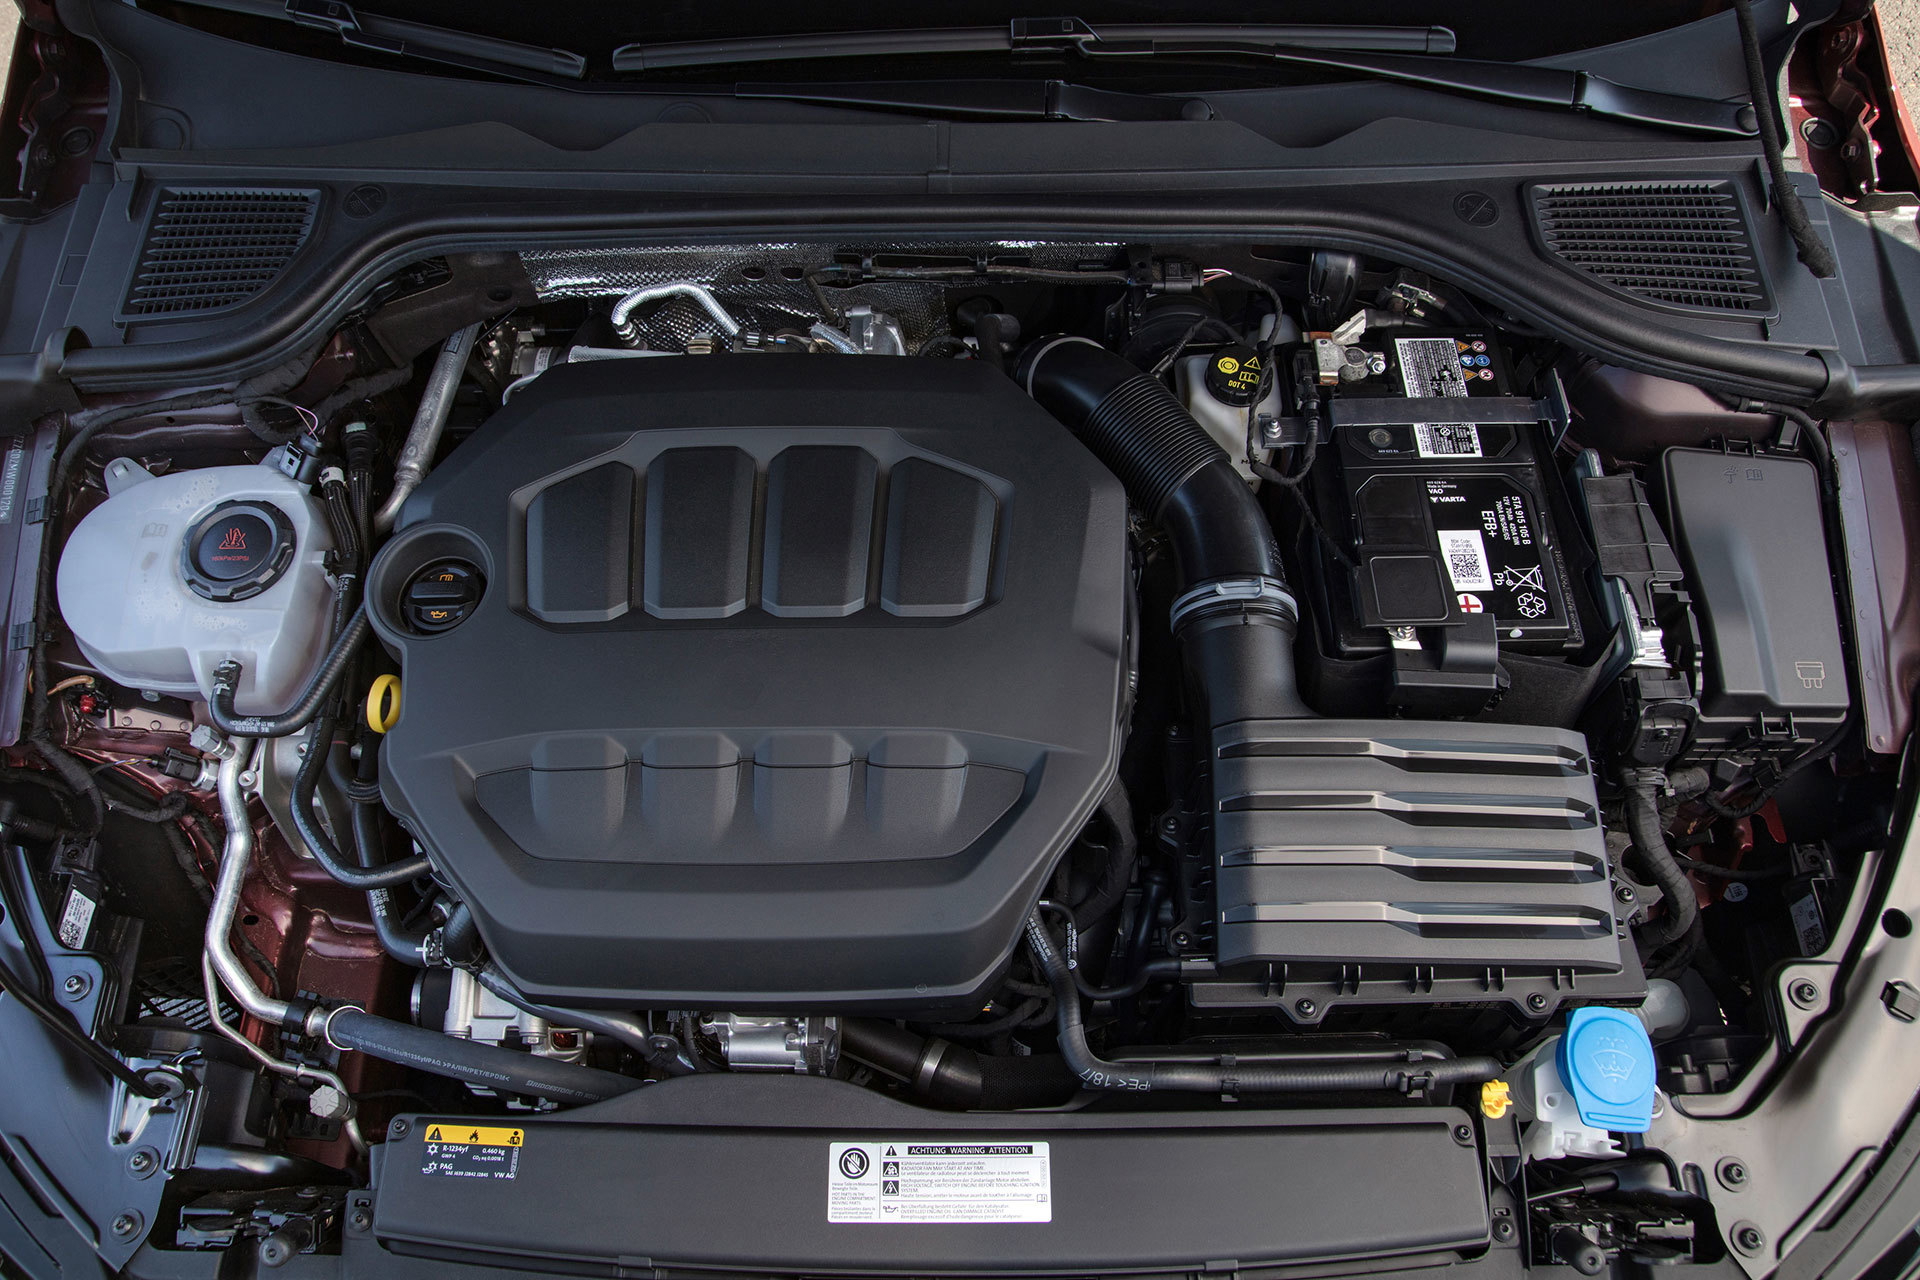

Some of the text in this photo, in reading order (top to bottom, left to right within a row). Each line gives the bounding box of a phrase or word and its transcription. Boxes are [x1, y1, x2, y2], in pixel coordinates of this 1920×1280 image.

[1228, 380, 1241, 388] DOT
[1512, 496, 1521, 509] 5TA
[1515, 510, 1526, 523] 915
[1481, 510, 1498, 537] EFB+
[1519, 526, 1530, 538] 105
[1493, 572, 1504, 586] Pb
[442, 1145, 469, 1154] R-1234yf
